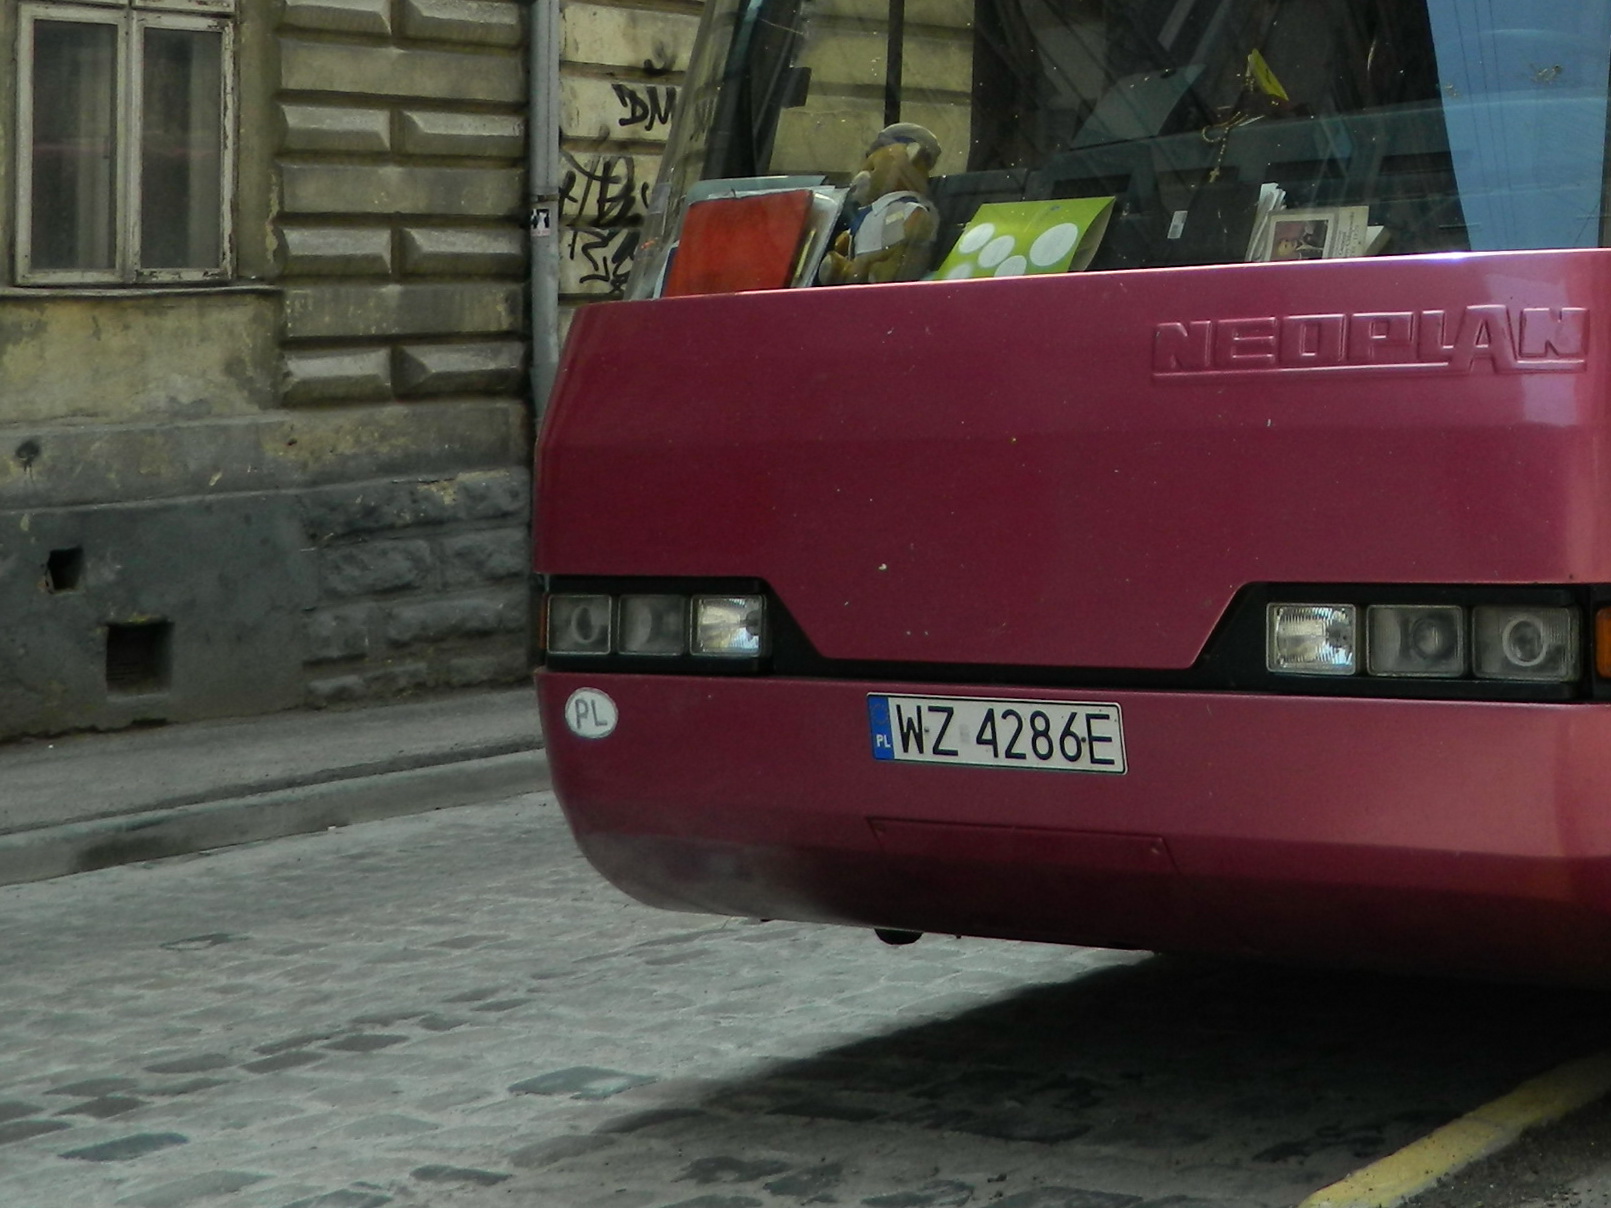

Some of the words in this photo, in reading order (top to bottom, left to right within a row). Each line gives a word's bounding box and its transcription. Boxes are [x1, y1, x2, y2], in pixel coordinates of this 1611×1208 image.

[1152, 304, 1590, 375] NEOPLAN
[575, 698, 608, 730] PL
[896, 704, 959, 757] WZ
[976, 708, 1115, 766] 4286E
[876, 735, 892, 749] PL
